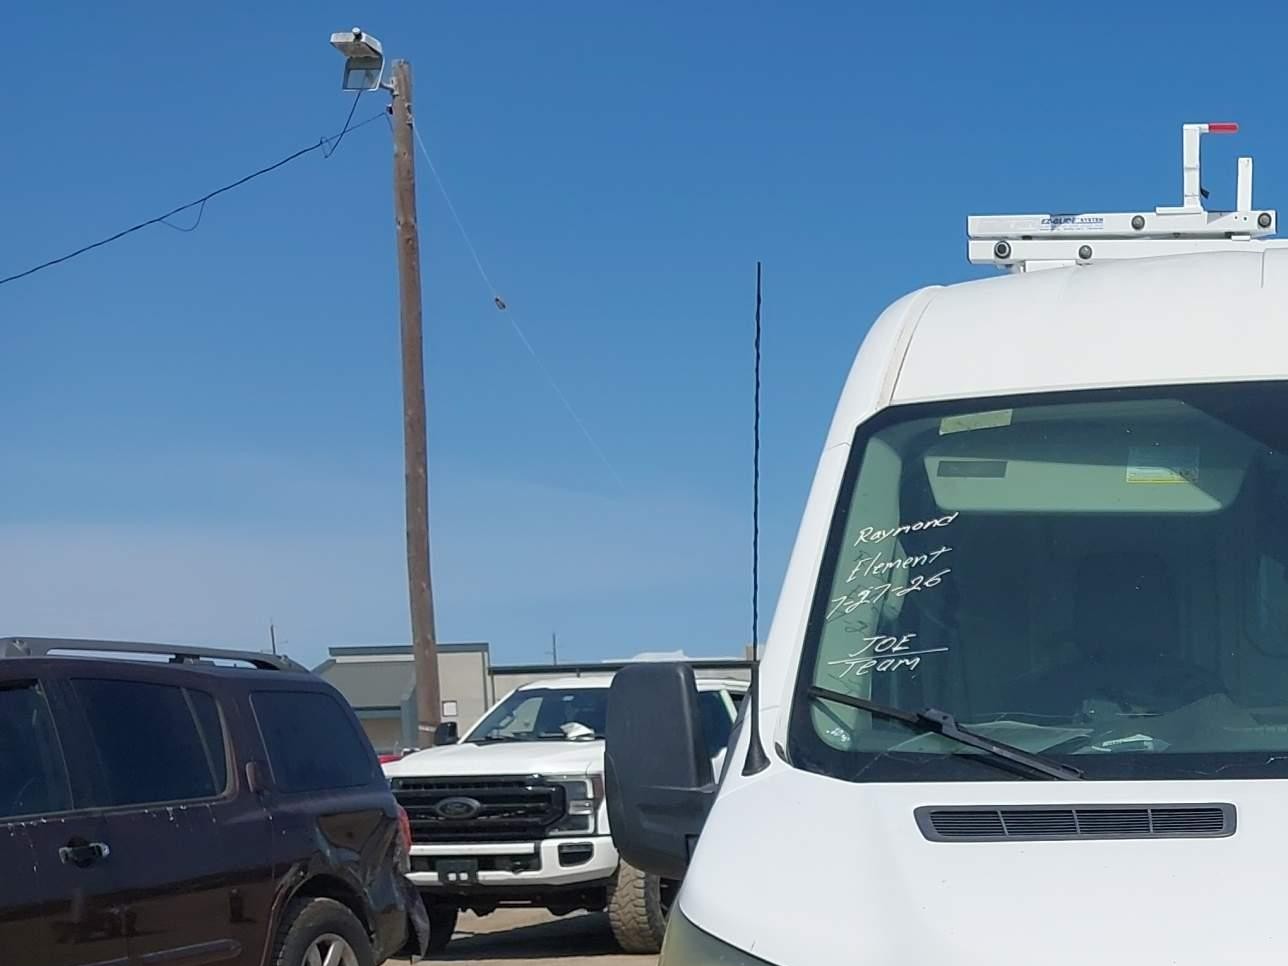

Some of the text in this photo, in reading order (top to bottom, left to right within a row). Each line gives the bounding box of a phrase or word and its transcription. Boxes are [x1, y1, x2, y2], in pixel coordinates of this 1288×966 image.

[854, 512, 959, 546] Raymond
[846, 546, 952, 583] Element
[826, 569, 951, 620] 7-27-26
[850, 634, 917, 657] JOE
